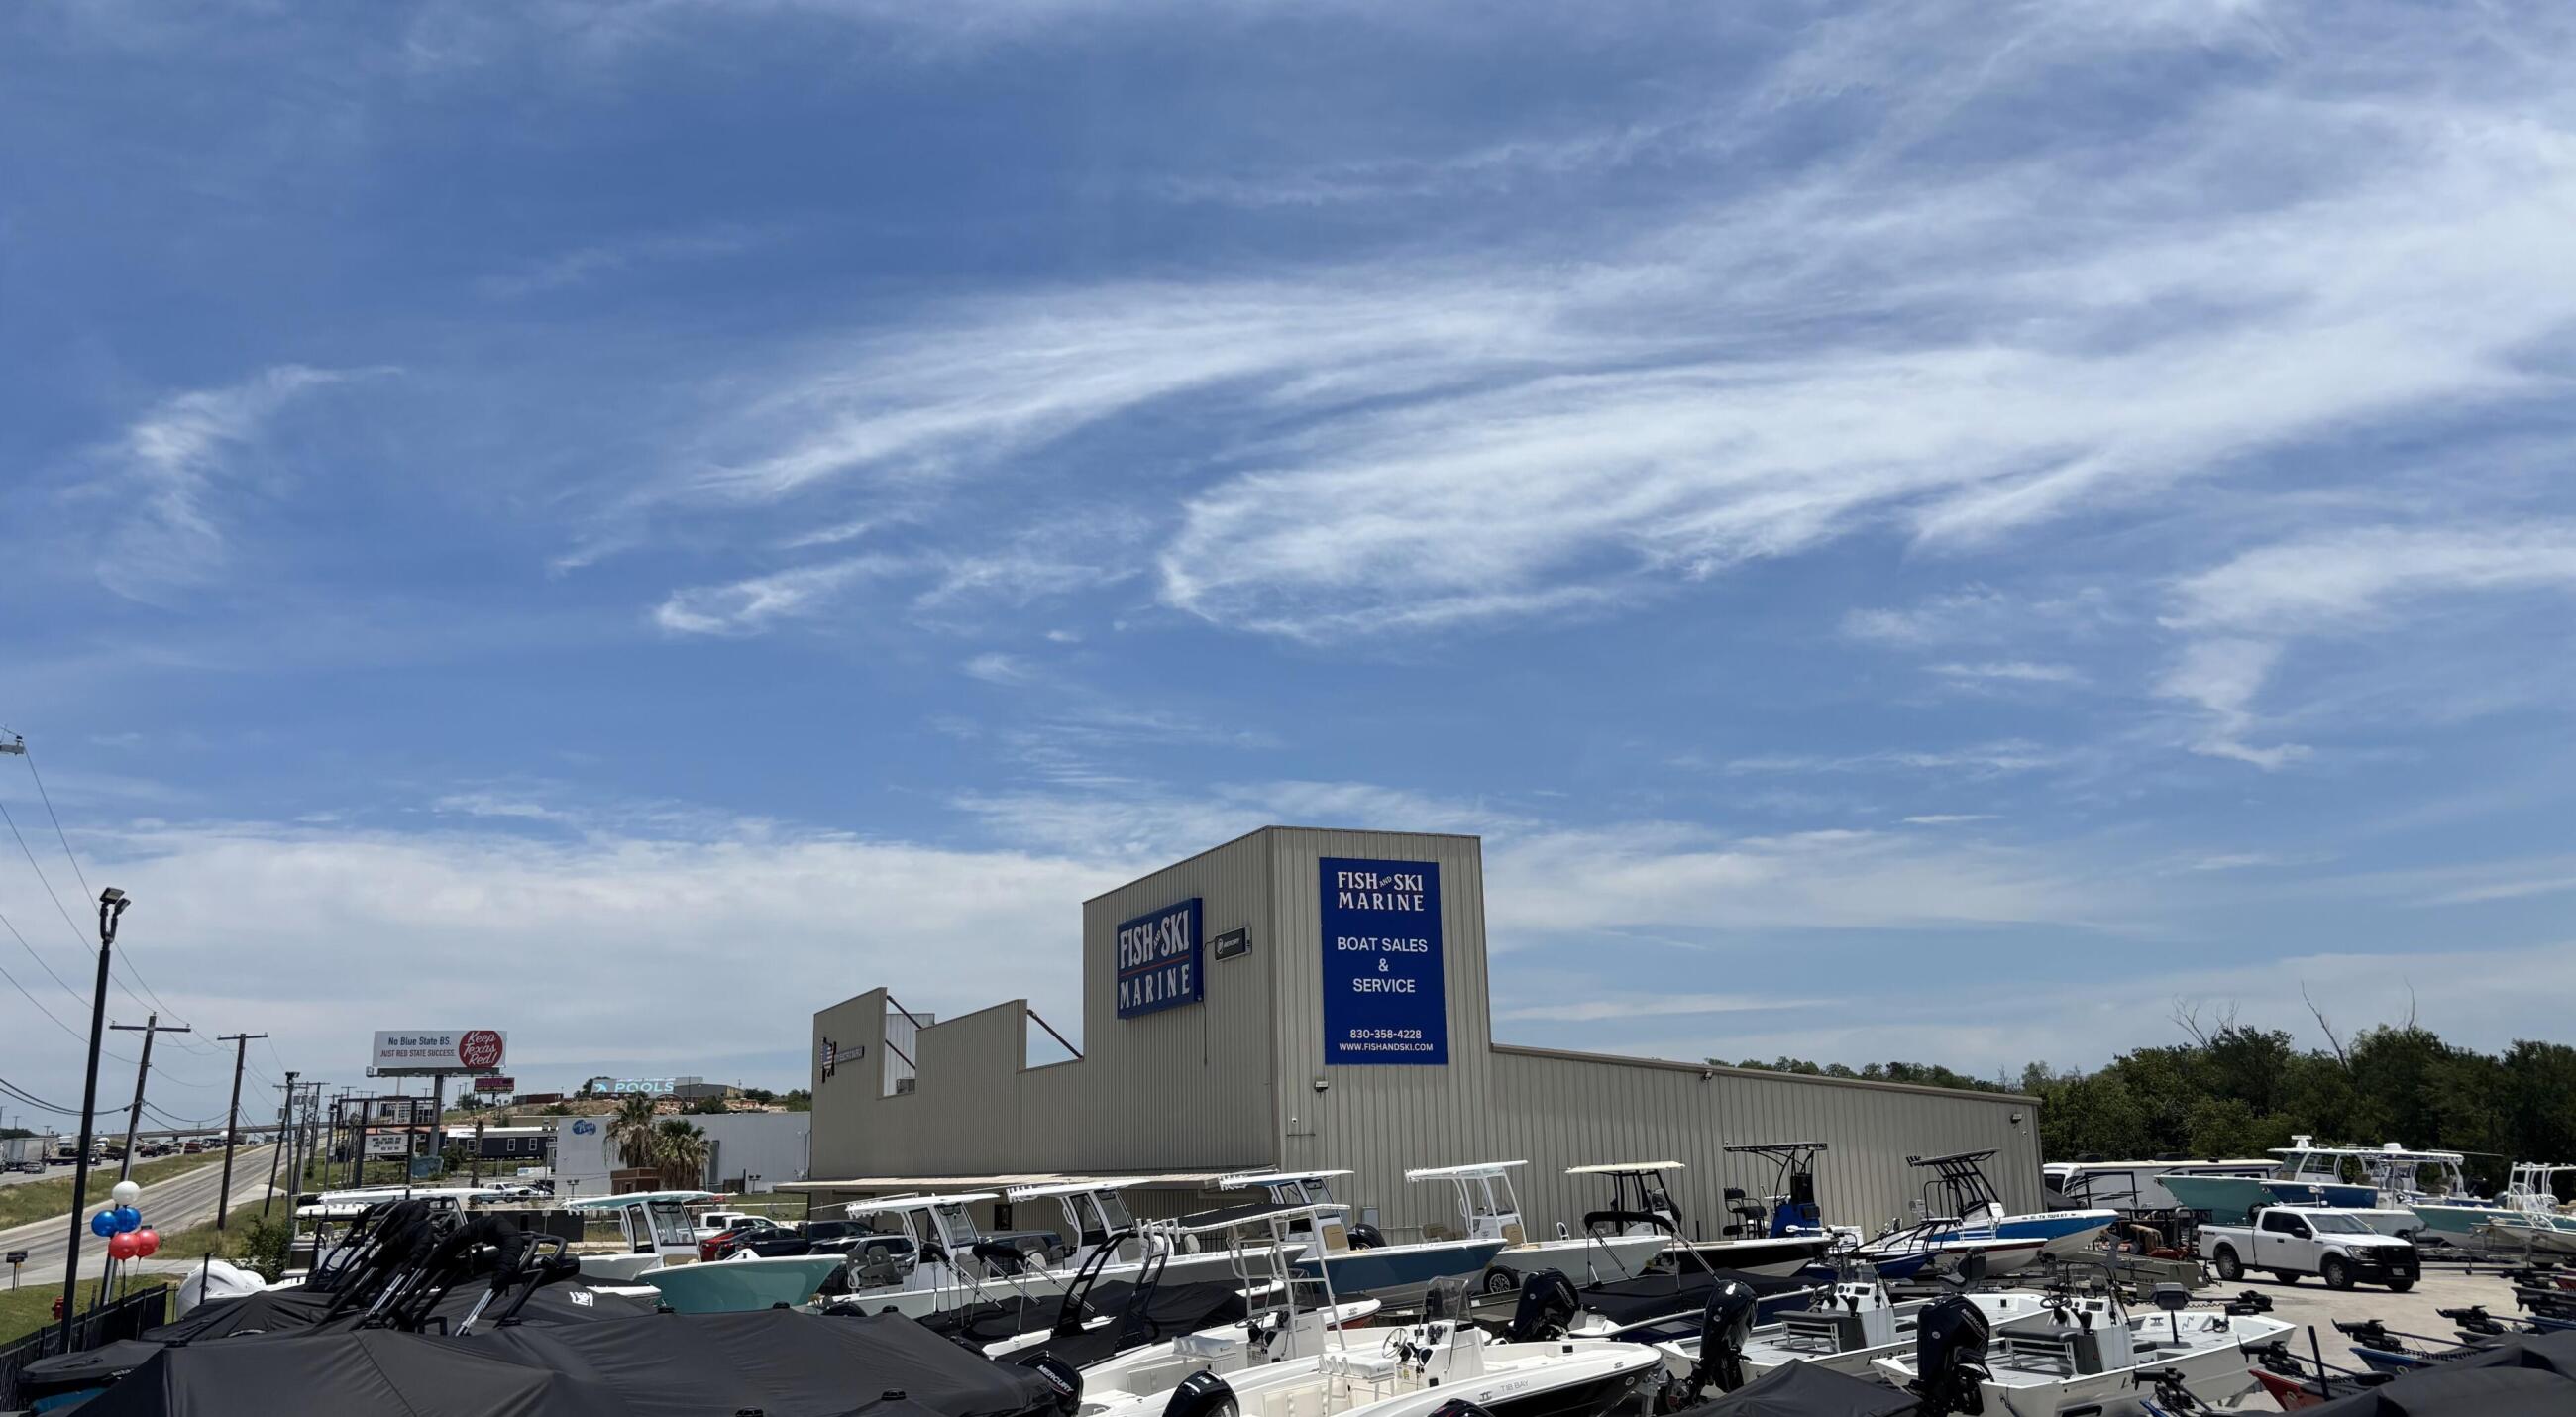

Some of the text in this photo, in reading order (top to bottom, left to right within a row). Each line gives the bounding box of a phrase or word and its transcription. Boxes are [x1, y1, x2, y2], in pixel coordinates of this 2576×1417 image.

[1338, 871, 1423, 891] FISH AND SKI
[1338, 891, 1425, 912] MARINE
[1120, 922, 1153, 969] FISH
[1160, 909, 1189, 957] SKI
[1337, 936, 1428, 952] BOAT SALES
[1378, 957, 1389, 972] &
[1120, 963, 1190, 1010] MARINE
[1352, 978, 1416, 993] SERVICE
[388, 1036, 451, 1045] No Blue State BS.
[467, 1031, 495, 1044] Keep
[1349, 1029, 1422, 1039] 830-358-4228
[463, 1041, 496, 1057] Texas
[1339, 1042, 1434, 1051] WWW.FISHANDSKI.COM
[469, 1052, 497, 1065] Red!
[614, 1081, 674, 1093] POOLS
[1961, 1308, 1988, 1337] MERCURY
[1036, 1364, 1074, 1392] MERCURY
